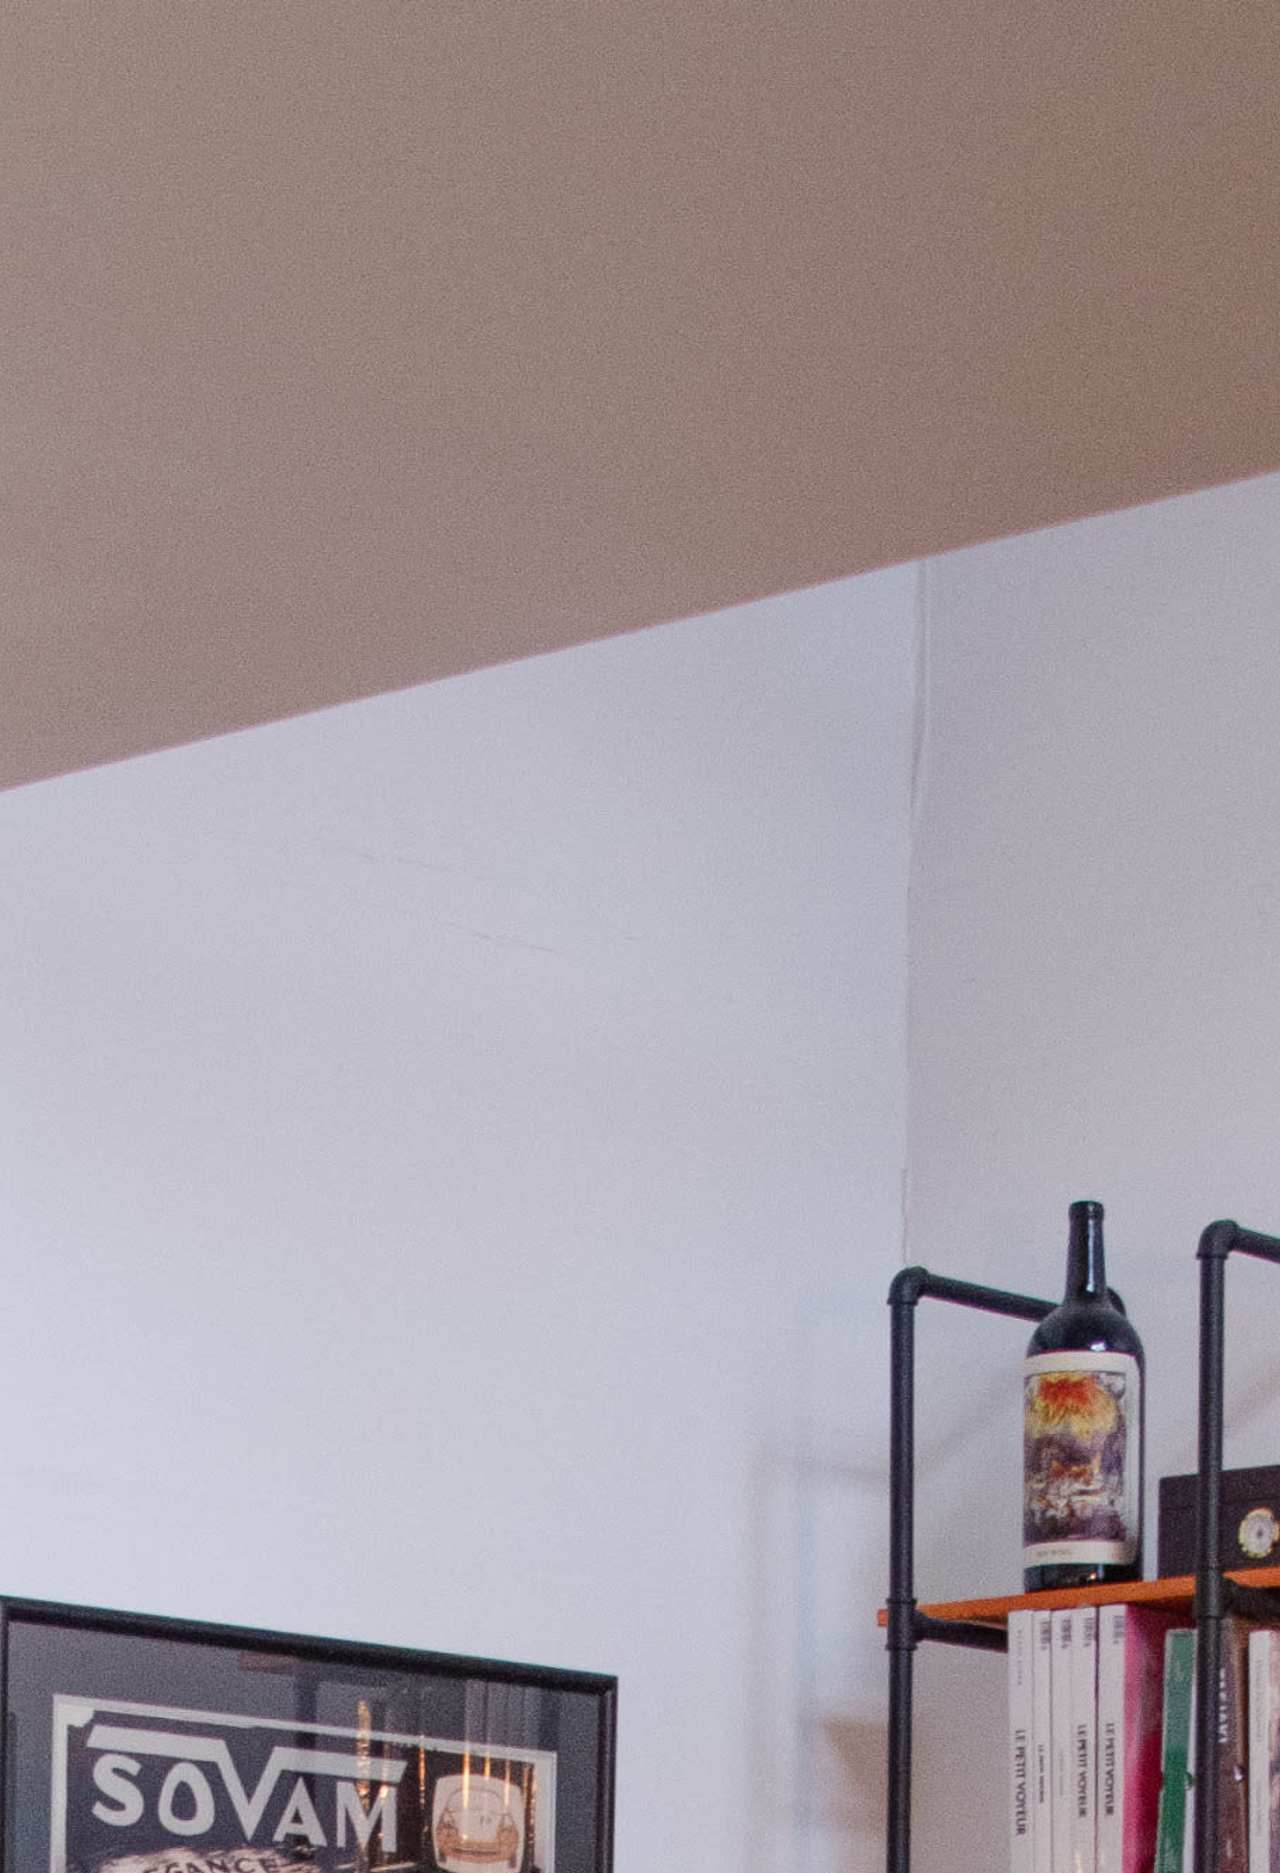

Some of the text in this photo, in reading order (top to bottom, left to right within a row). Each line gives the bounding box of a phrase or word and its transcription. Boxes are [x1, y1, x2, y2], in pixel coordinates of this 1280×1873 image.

[86, 1724, 408, 1853] SOVAM
[1015, 1729, 1027, 1836] LE PETIT VOYEUR
